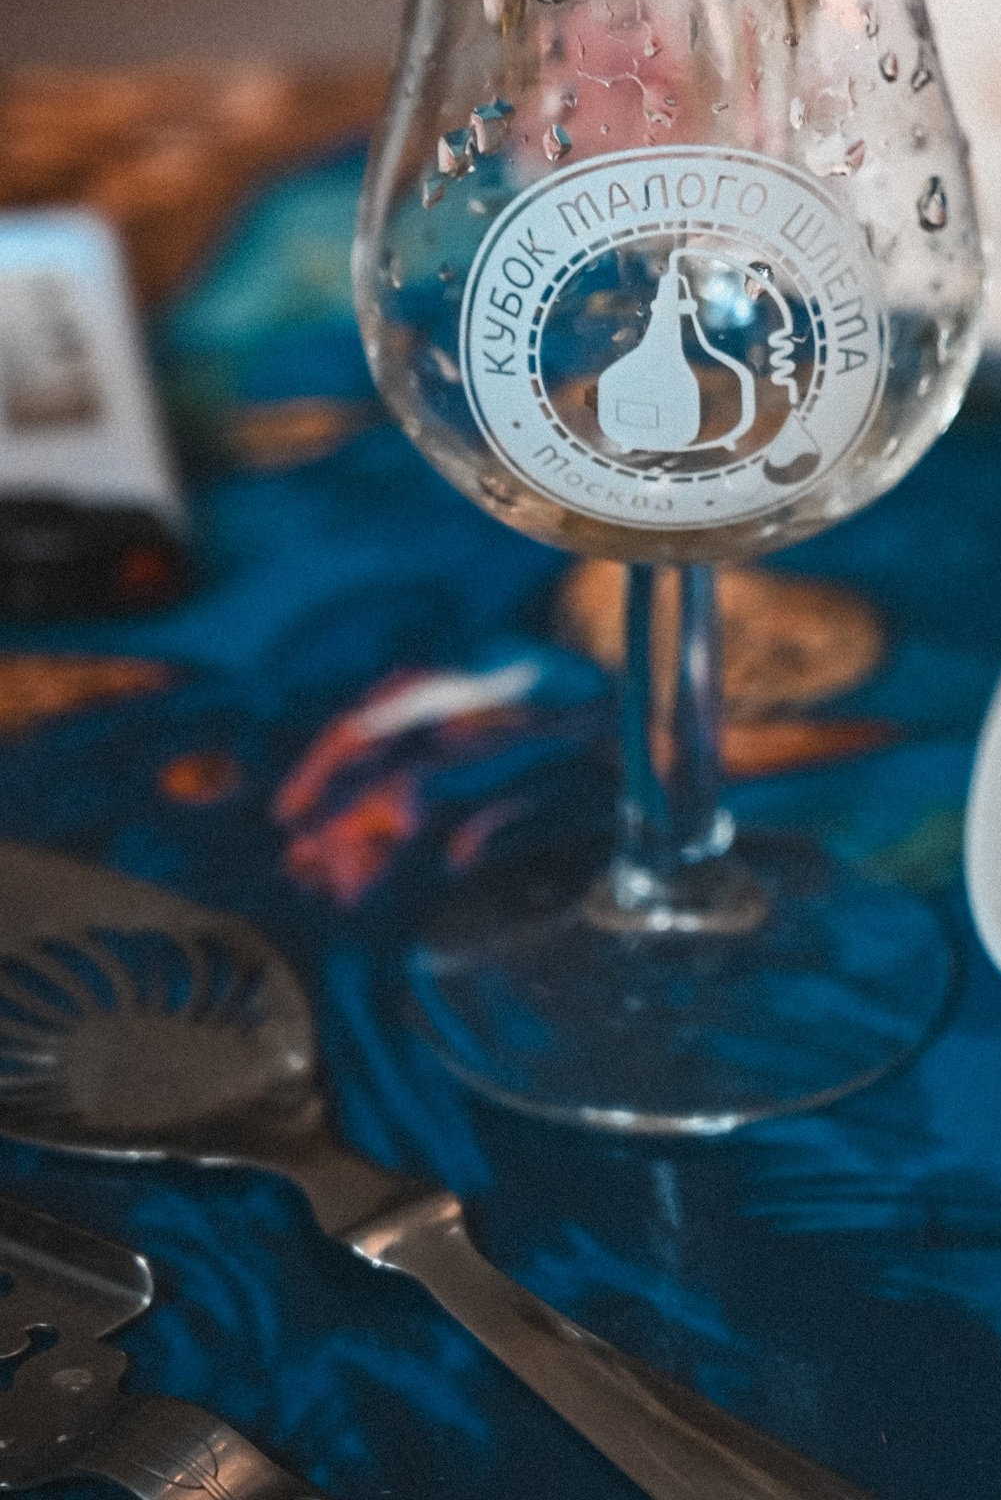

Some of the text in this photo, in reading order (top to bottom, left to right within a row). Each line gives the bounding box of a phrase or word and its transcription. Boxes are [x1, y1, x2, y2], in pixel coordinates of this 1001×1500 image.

[483, 171, 869, 377] КУБОК МАЛОГО ШЛЕМА
